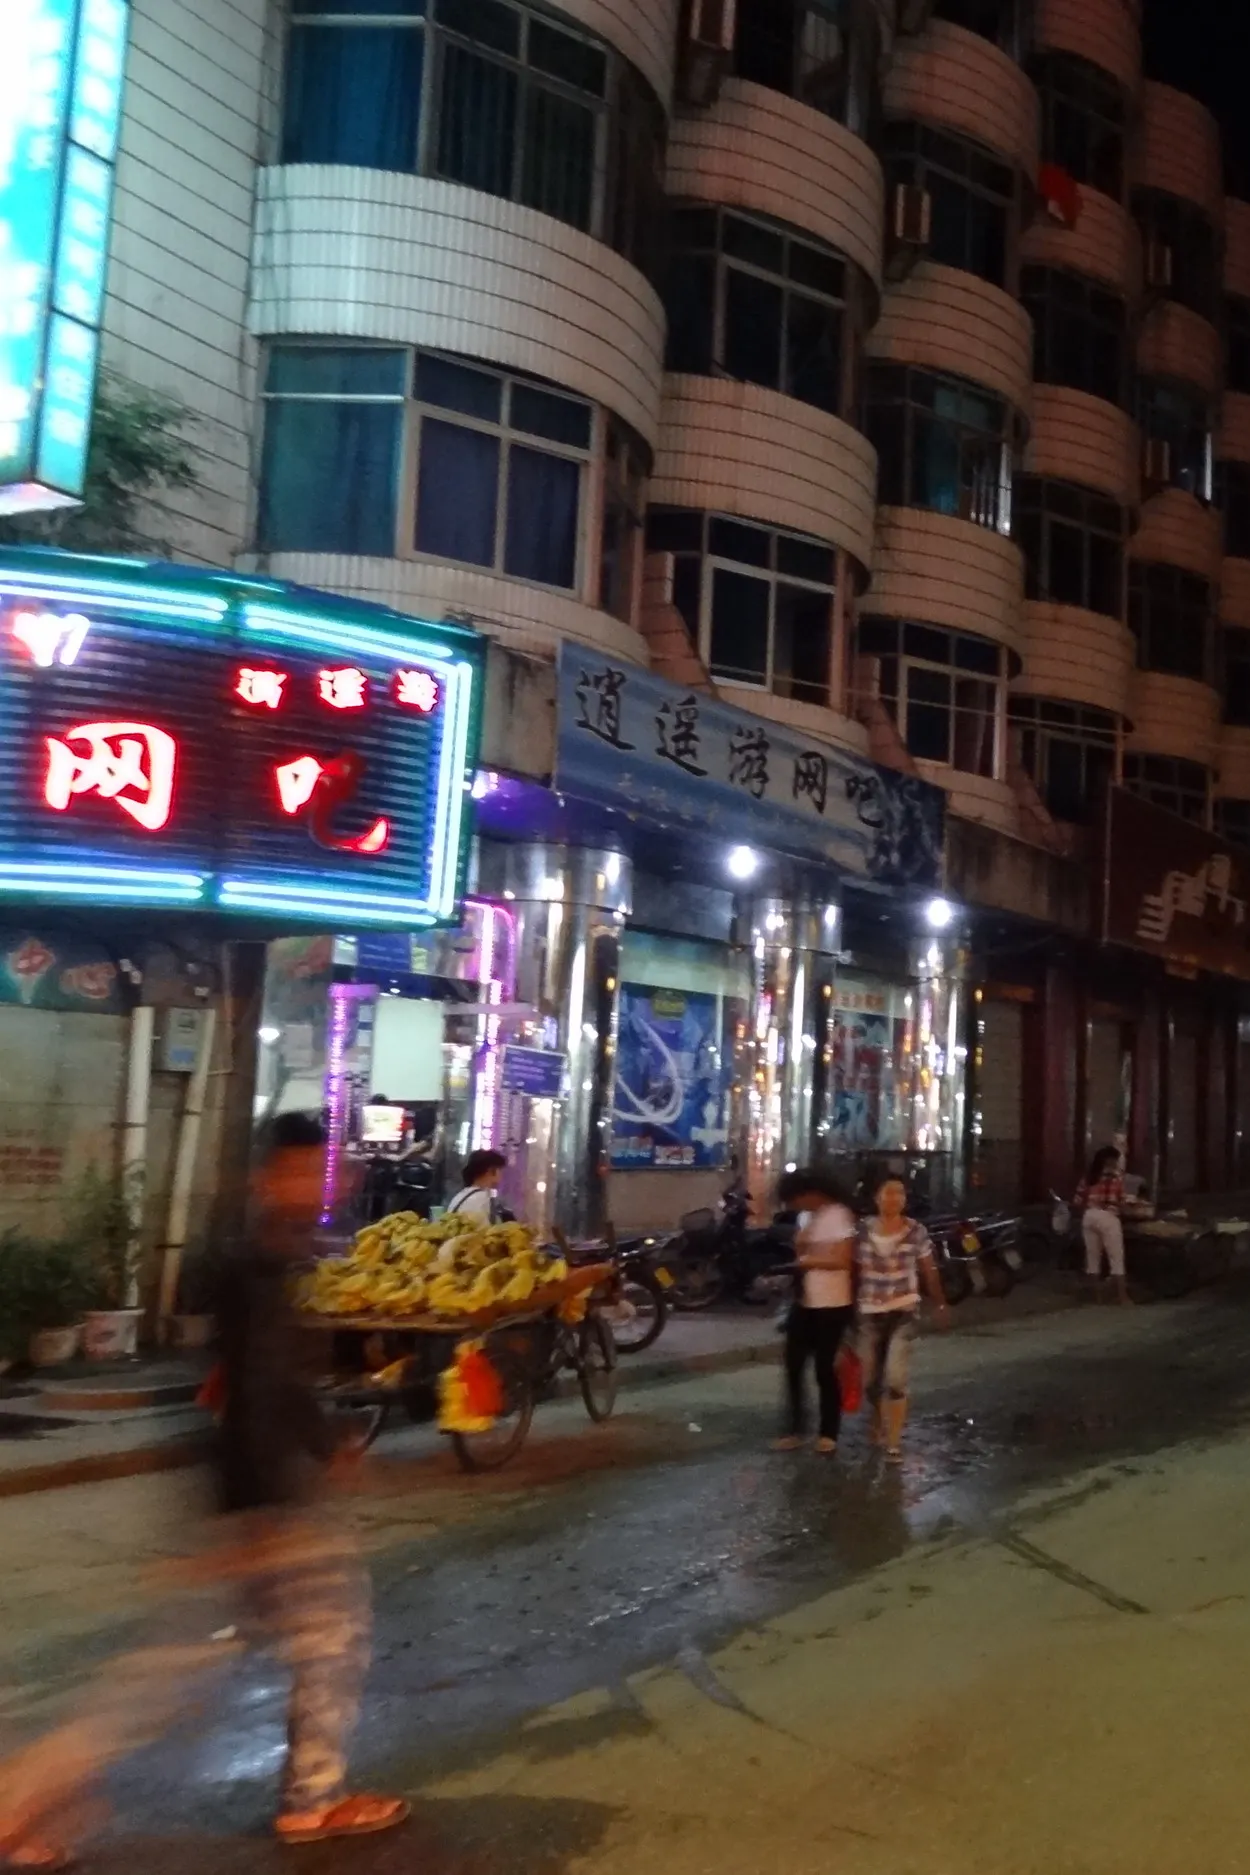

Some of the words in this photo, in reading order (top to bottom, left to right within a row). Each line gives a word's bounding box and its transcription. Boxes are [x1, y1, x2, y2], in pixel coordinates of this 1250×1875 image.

[45, 721, 389, 853] 网吧
[574, 667, 884, 828] 逍遥游网吧
